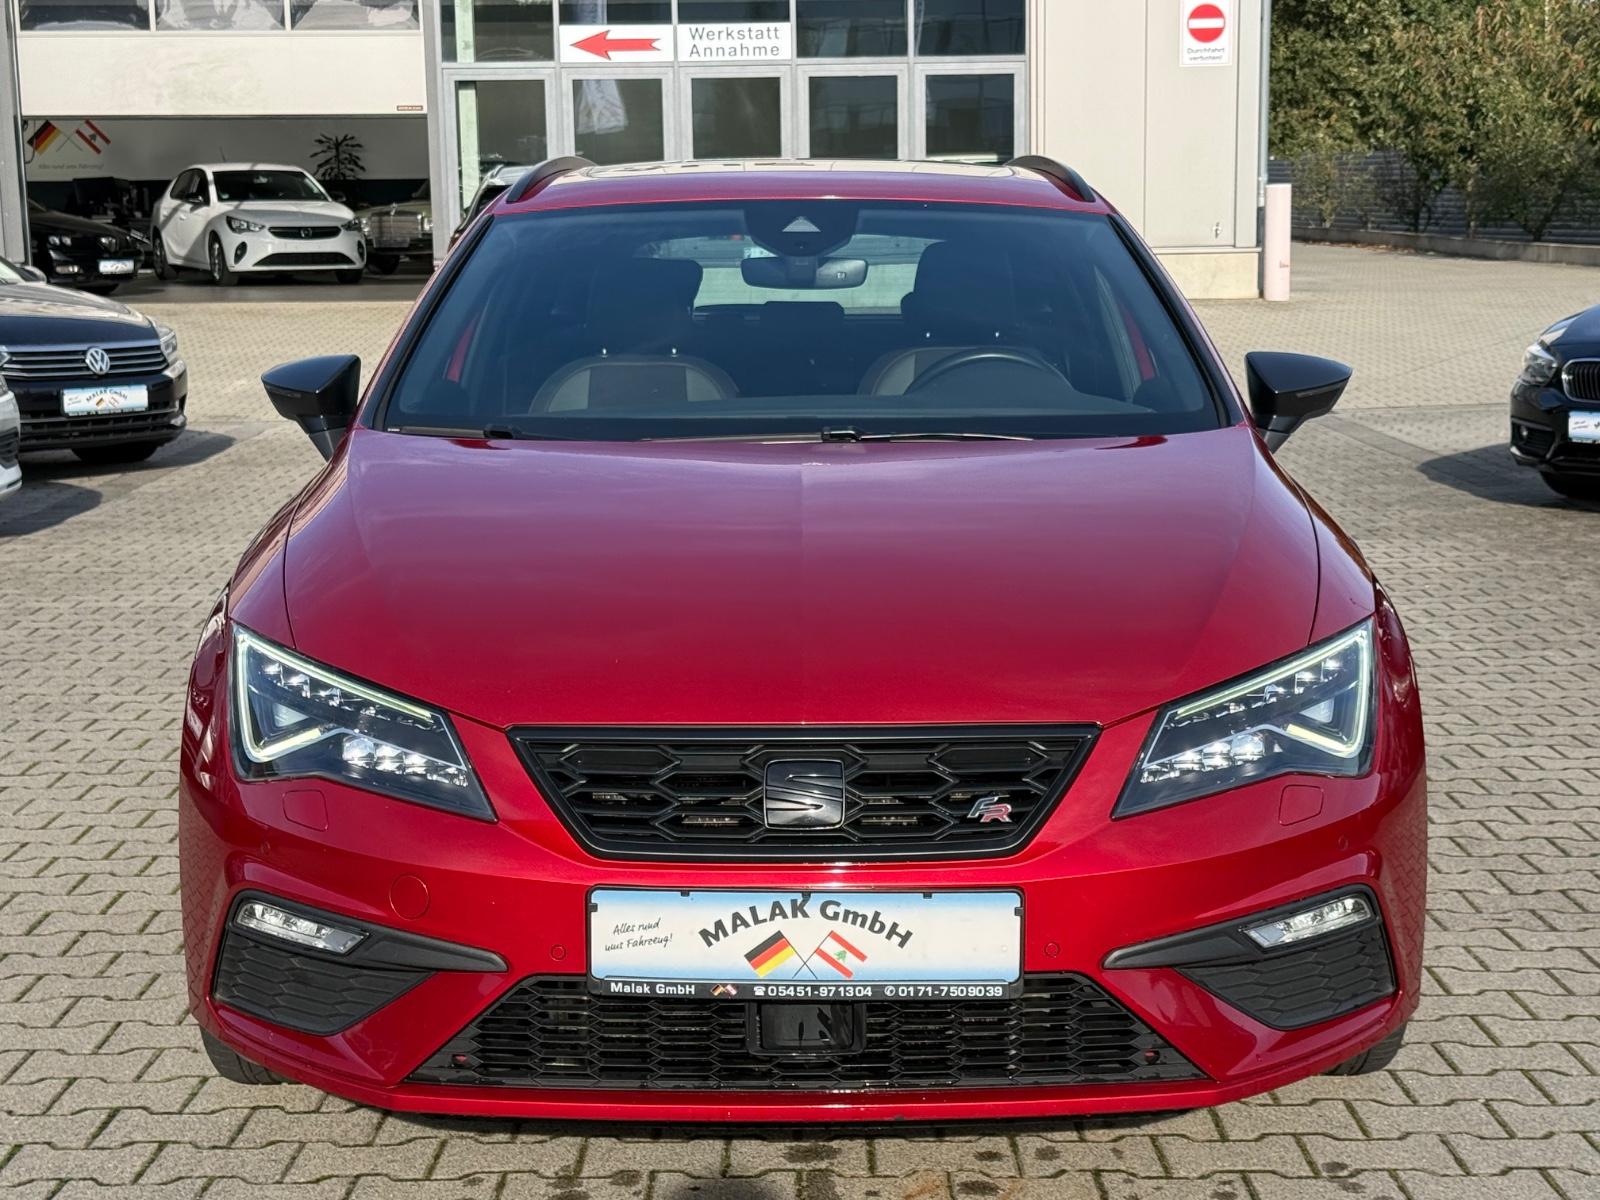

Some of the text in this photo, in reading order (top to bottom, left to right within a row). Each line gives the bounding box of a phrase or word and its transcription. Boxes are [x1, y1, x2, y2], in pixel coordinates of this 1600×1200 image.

[689, 26, 780, 41] Werkstatt
[689, 43, 780, 58] Annahme
[967, 796, 1012, 822] FR
[613, 916, 662, 936] Alles rund
[698, 898, 913, 949] MALAK GmbH
[604, 933, 673, 952] ums Fahrzeug!
[610, 982, 1003, 997] Malak GmbH 05451-971304 0171-7509039
